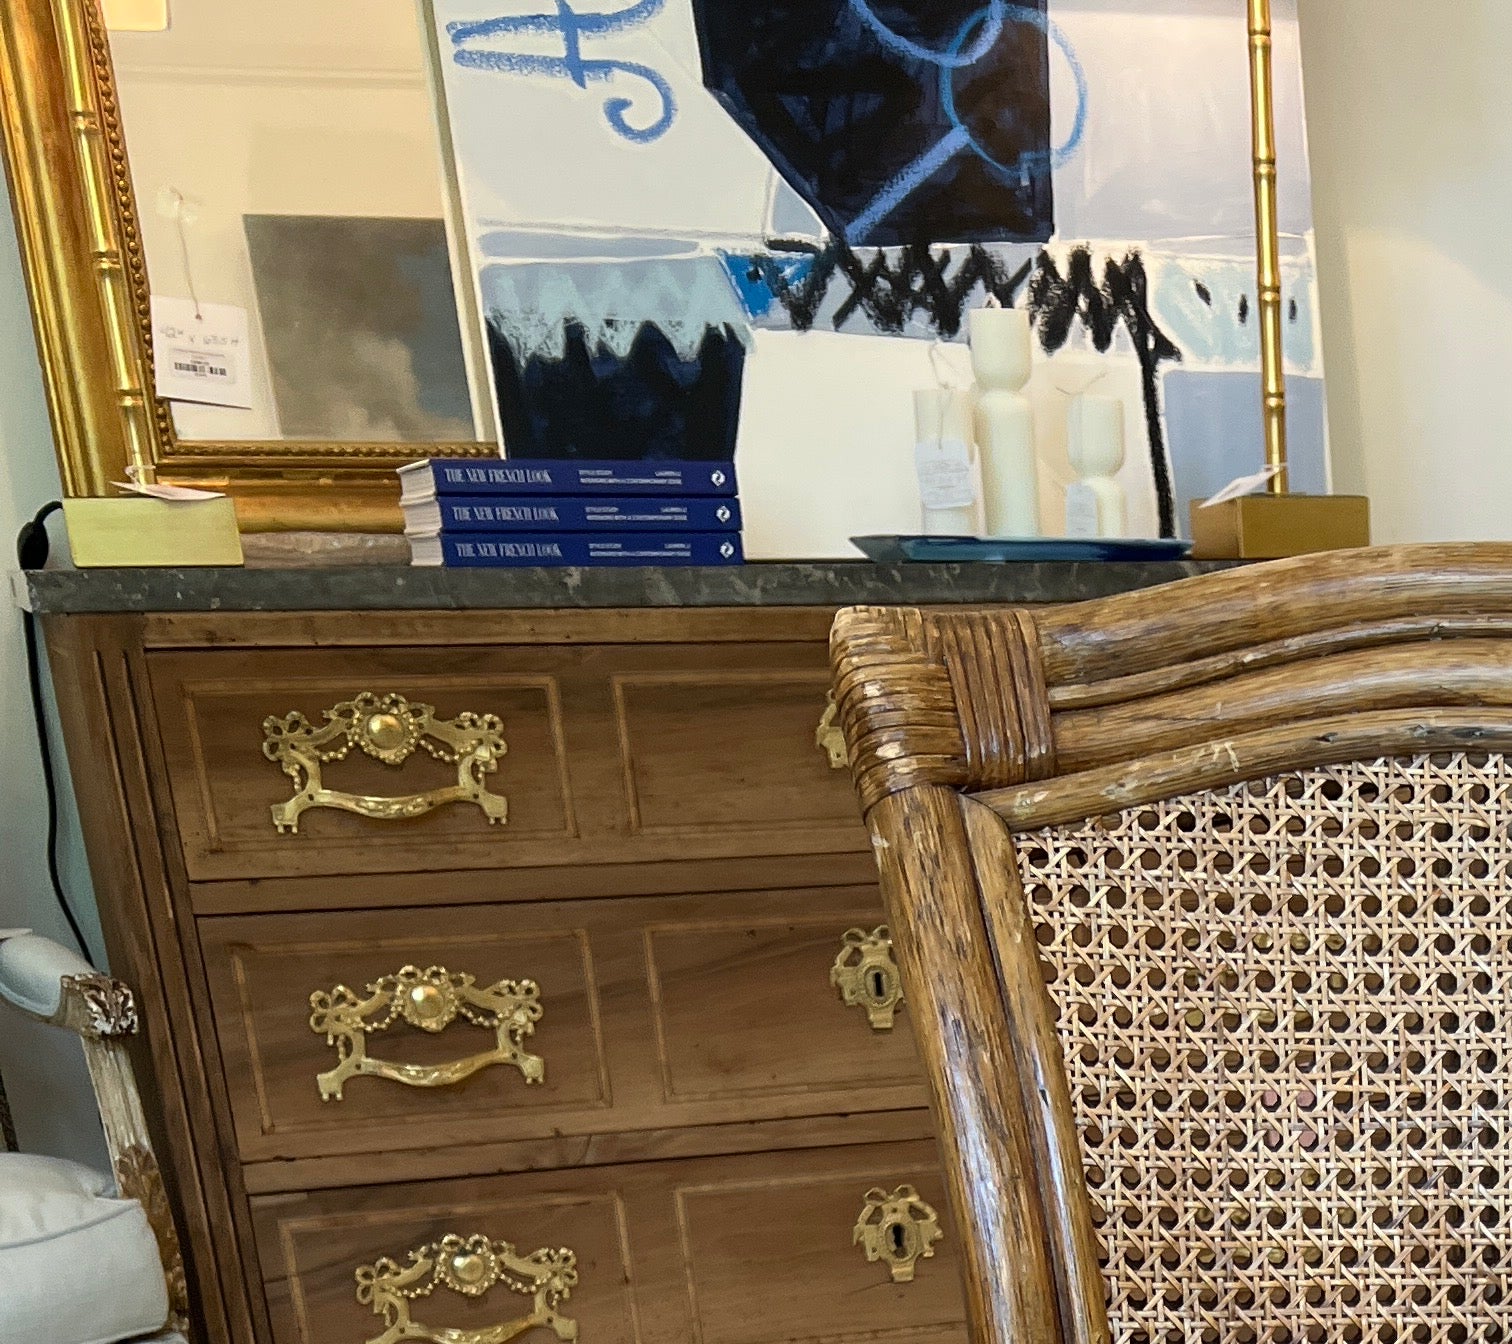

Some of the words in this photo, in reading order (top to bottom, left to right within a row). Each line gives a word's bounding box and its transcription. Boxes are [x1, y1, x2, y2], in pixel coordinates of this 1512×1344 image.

[444, 468, 464, 483] THE
[465, 468, 487, 483] NEW
[488, 468, 525, 483] FRENCH
[452, 506, 471, 521] THE
[473, 506, 494, 521] NEW
[495, 506, 532, 521] FRENCH
[455, 543, 475, 557] THE
[477, 543, 497, 557] NEW
[498, 543, 536, 557] FRENCH
